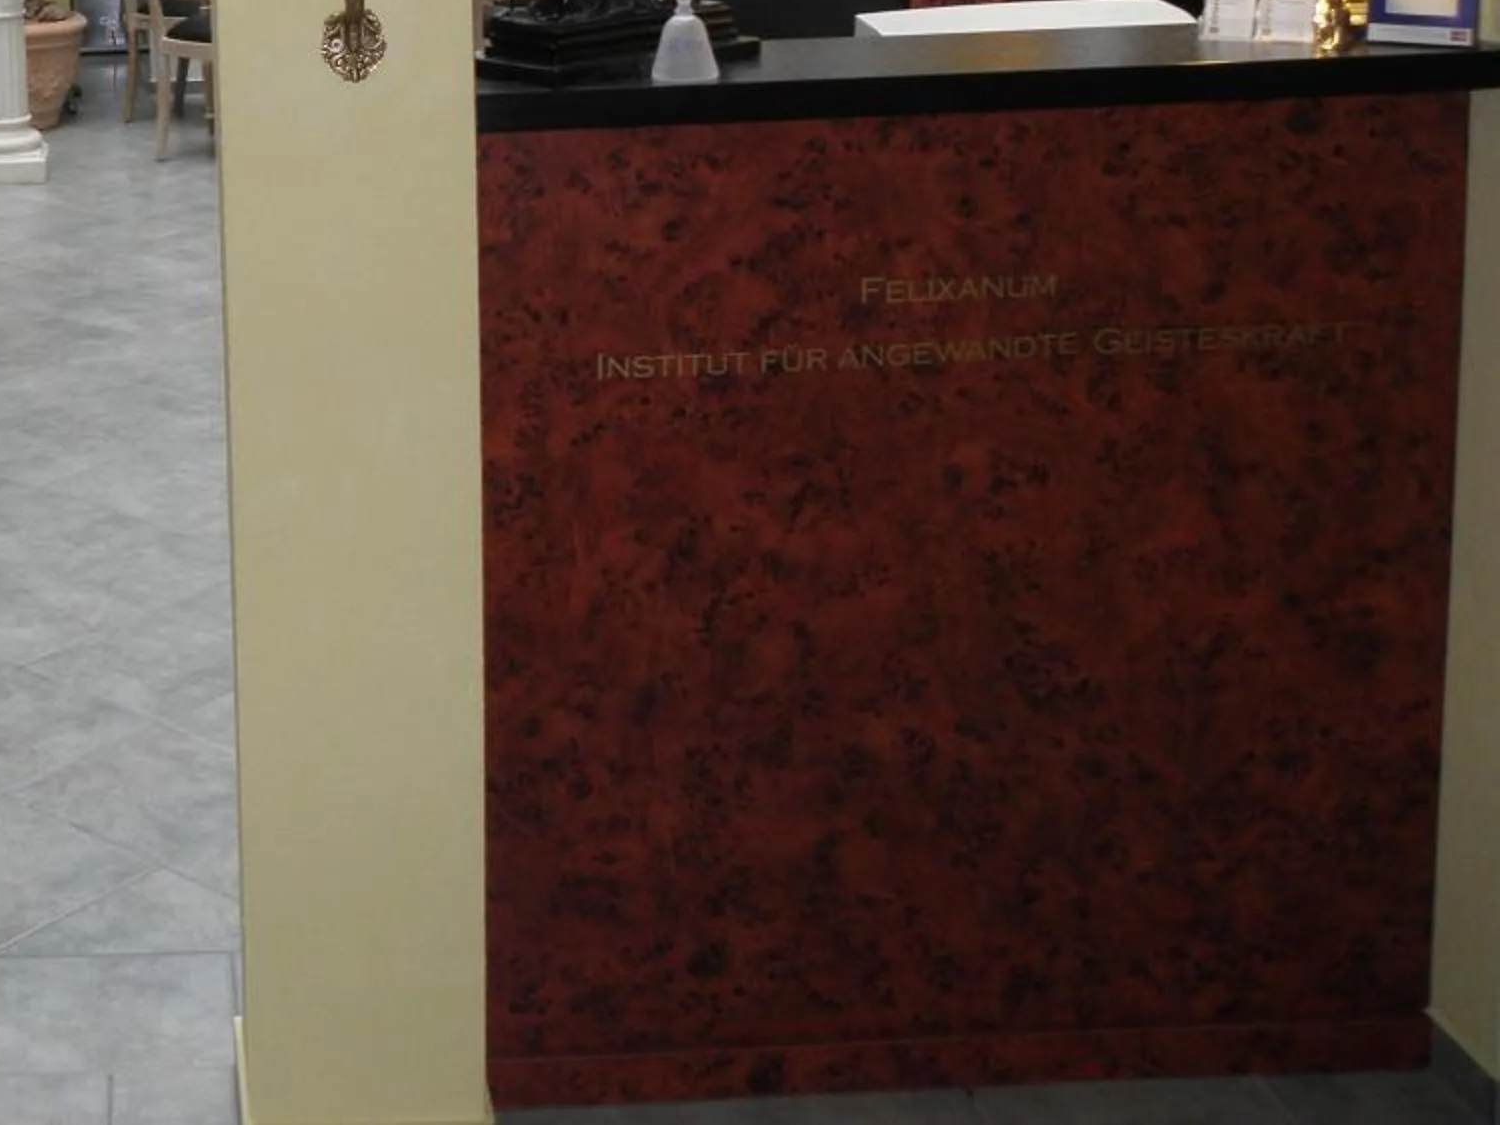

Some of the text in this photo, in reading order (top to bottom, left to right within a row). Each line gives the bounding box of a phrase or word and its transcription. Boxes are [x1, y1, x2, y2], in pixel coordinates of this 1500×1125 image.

[860, 272, 1058, 305] FELIXANUM
[596, 349, 750, 381] INSTITUT
[759, 345, 828, 375] FÜR
[837, 331, 1079, 370] ANGEWANDTE
